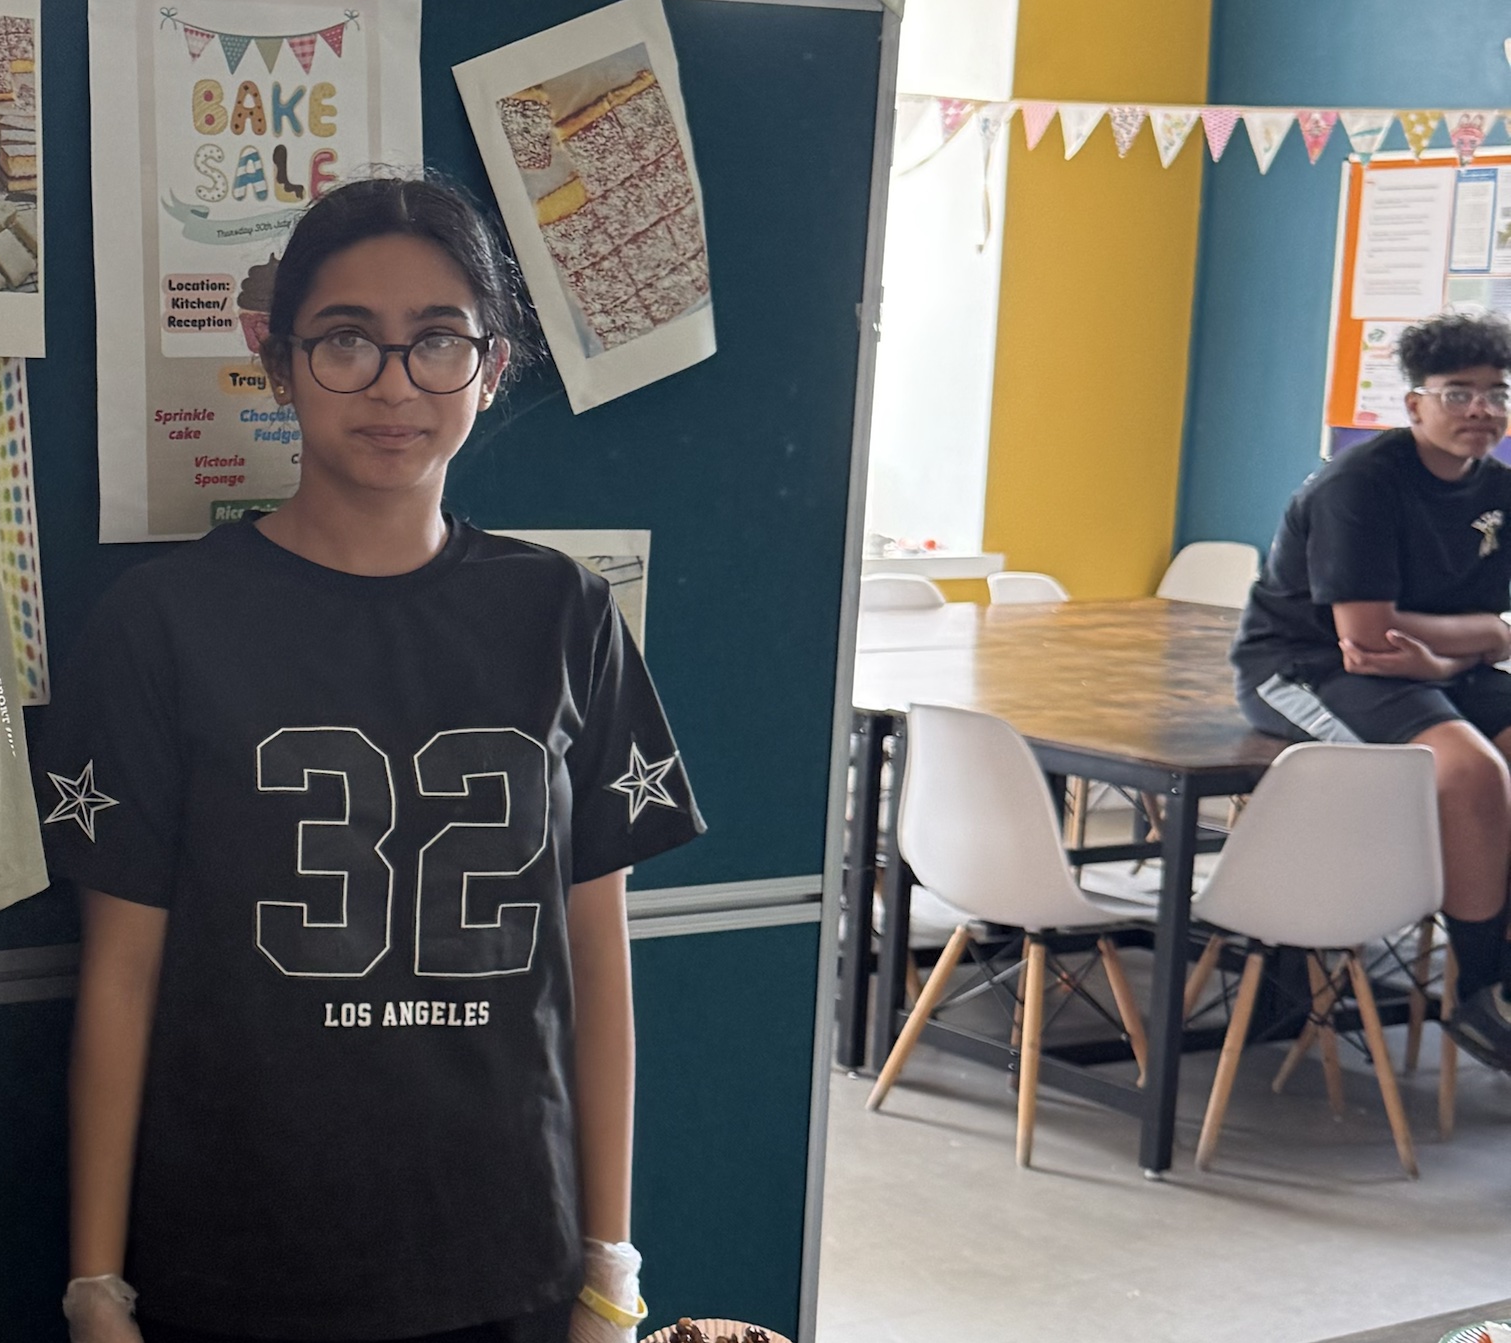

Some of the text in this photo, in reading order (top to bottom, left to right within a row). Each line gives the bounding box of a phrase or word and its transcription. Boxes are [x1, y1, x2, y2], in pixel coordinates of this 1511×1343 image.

[191, 78, 338, 138] BAKE
[193, 143, 338, 202] SALE
[216, 224, 254, 239] Thursday
[254, 222, 273, 232] 30th
[168, 279, 231, 292] Location:
[171, 296, 229, 311] Kitchen/
[167, 316, 233, 331] Reception
[229, 372, 266, 390] Tray
[154, 408, 297, 425] Sprinkle Chocola
[169, 427, 300, 444] cake Fudge
[194, 455, 246, 468] Victoria
[194, 472, 246, 488] Sponge
[256, 726, 549, 977] 32
[324, 1001, 490, 1027] LOS ANGELES
